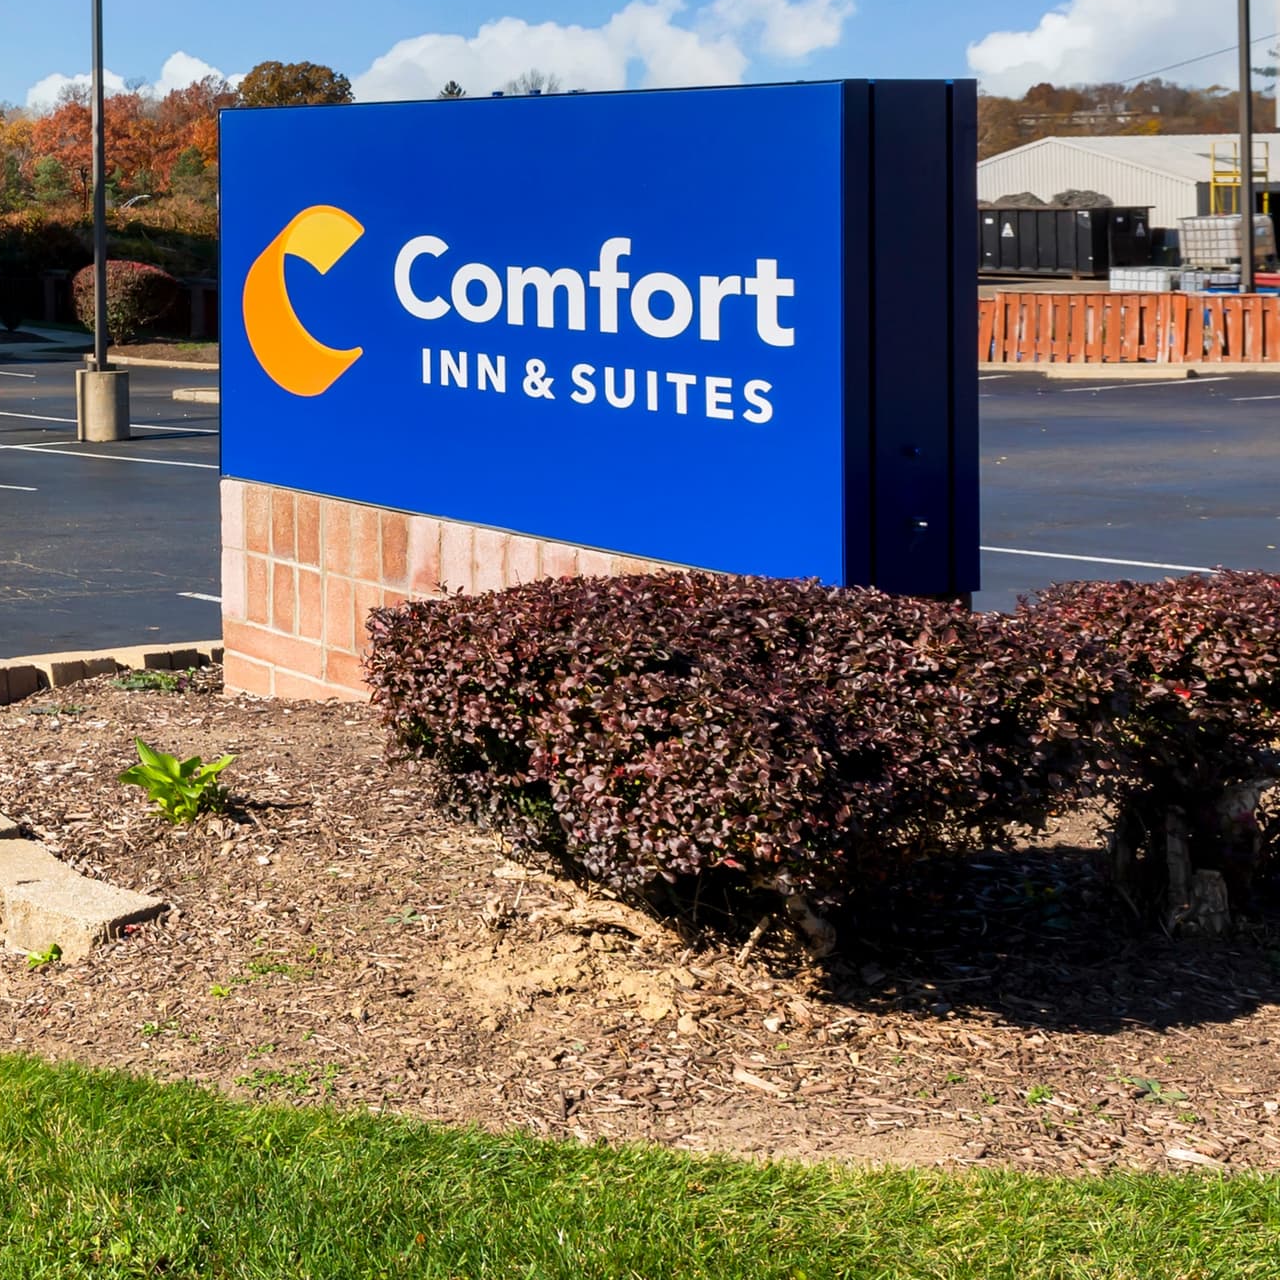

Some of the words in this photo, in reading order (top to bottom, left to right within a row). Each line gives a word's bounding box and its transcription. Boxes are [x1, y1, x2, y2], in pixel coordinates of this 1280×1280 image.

[394, 235, 795, 347] Comfort
[422, 348, 506, 393] INN
[522, 358, 556, 400] &
[570, 363, 773, 424] SUITES
